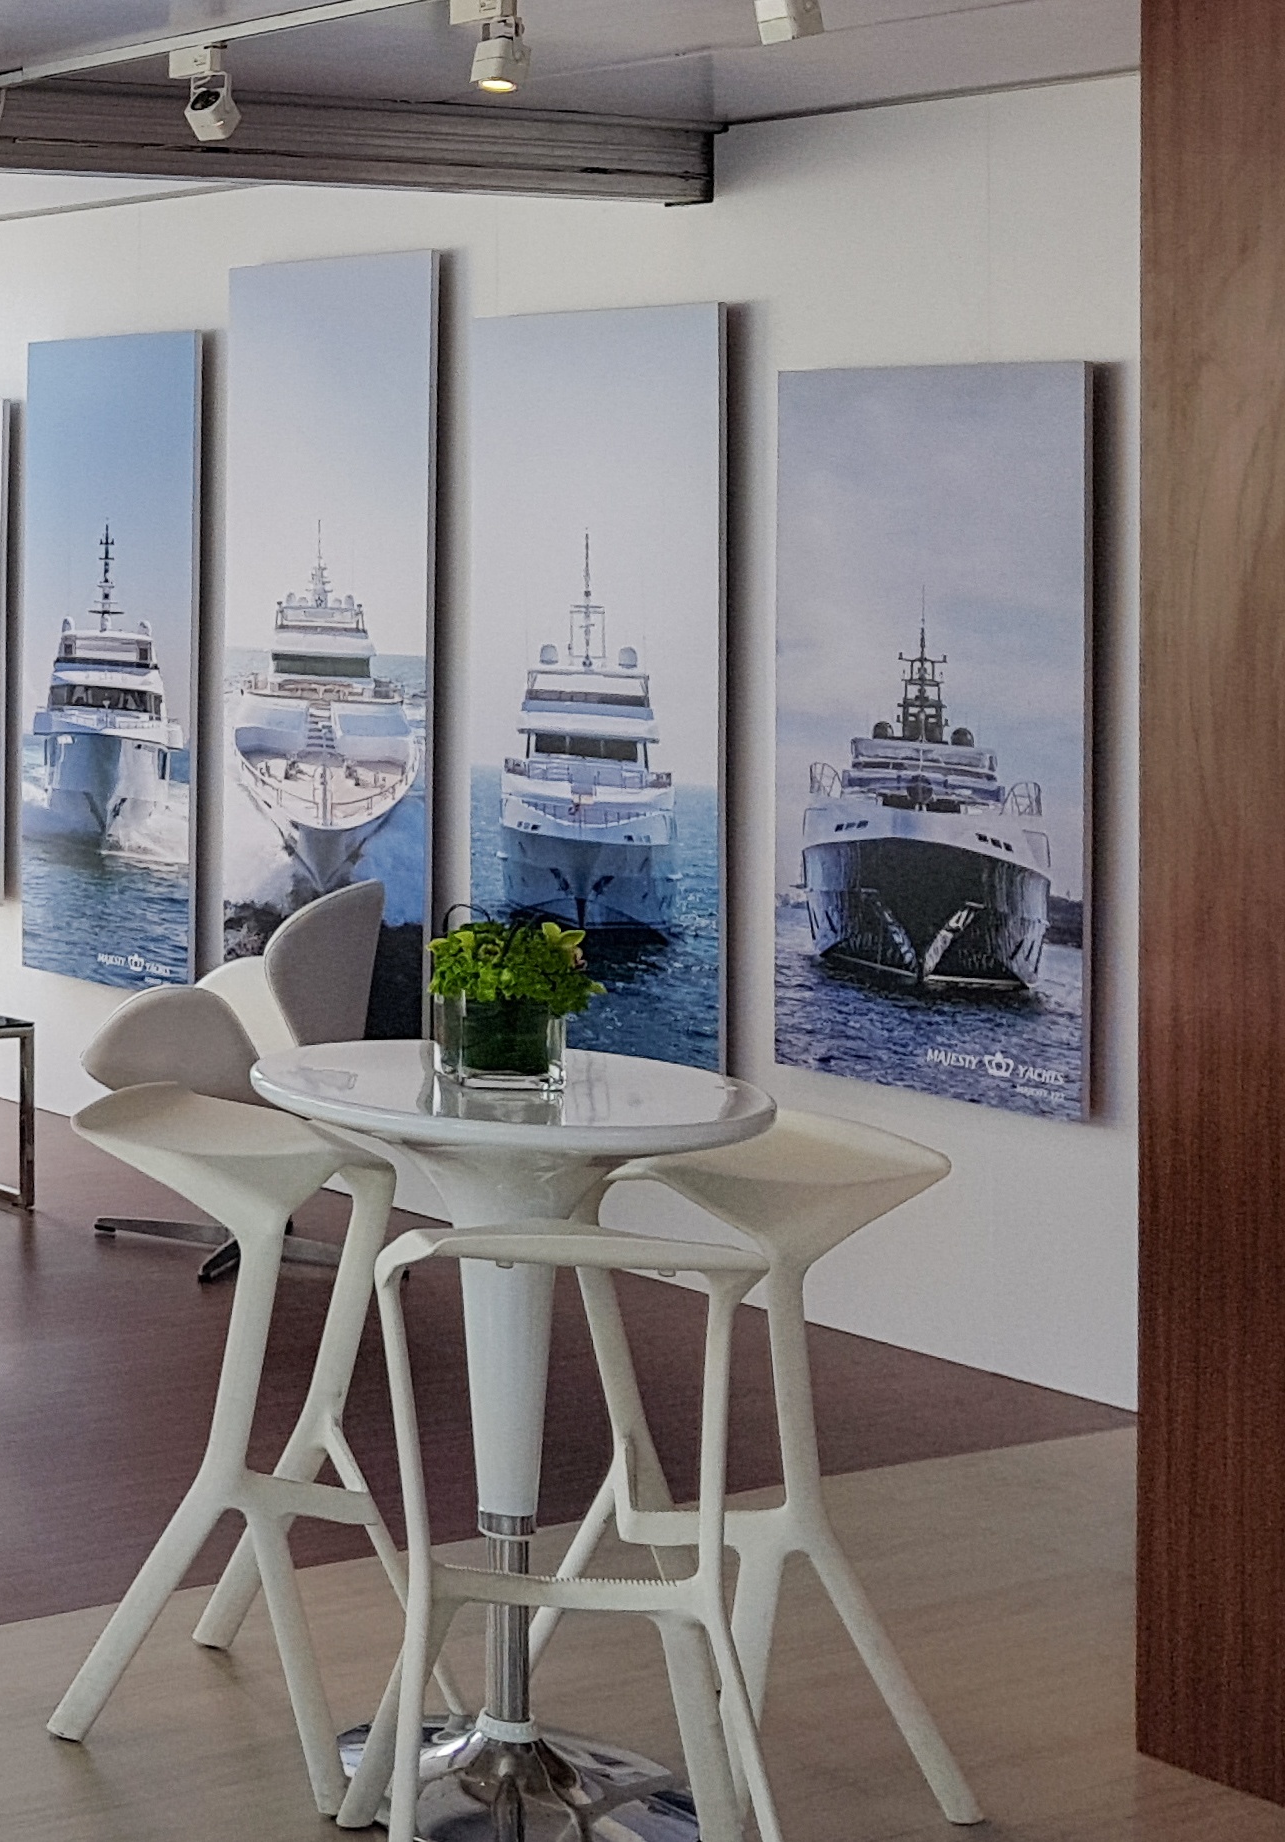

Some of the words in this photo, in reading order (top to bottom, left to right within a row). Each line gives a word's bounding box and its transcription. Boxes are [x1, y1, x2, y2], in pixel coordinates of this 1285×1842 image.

[97, 953, 127, 967] MAJESTY
[927, 1049, 979, 1070] MAJESTY
[1018, 1065, 1065, 1086] YACHTS
